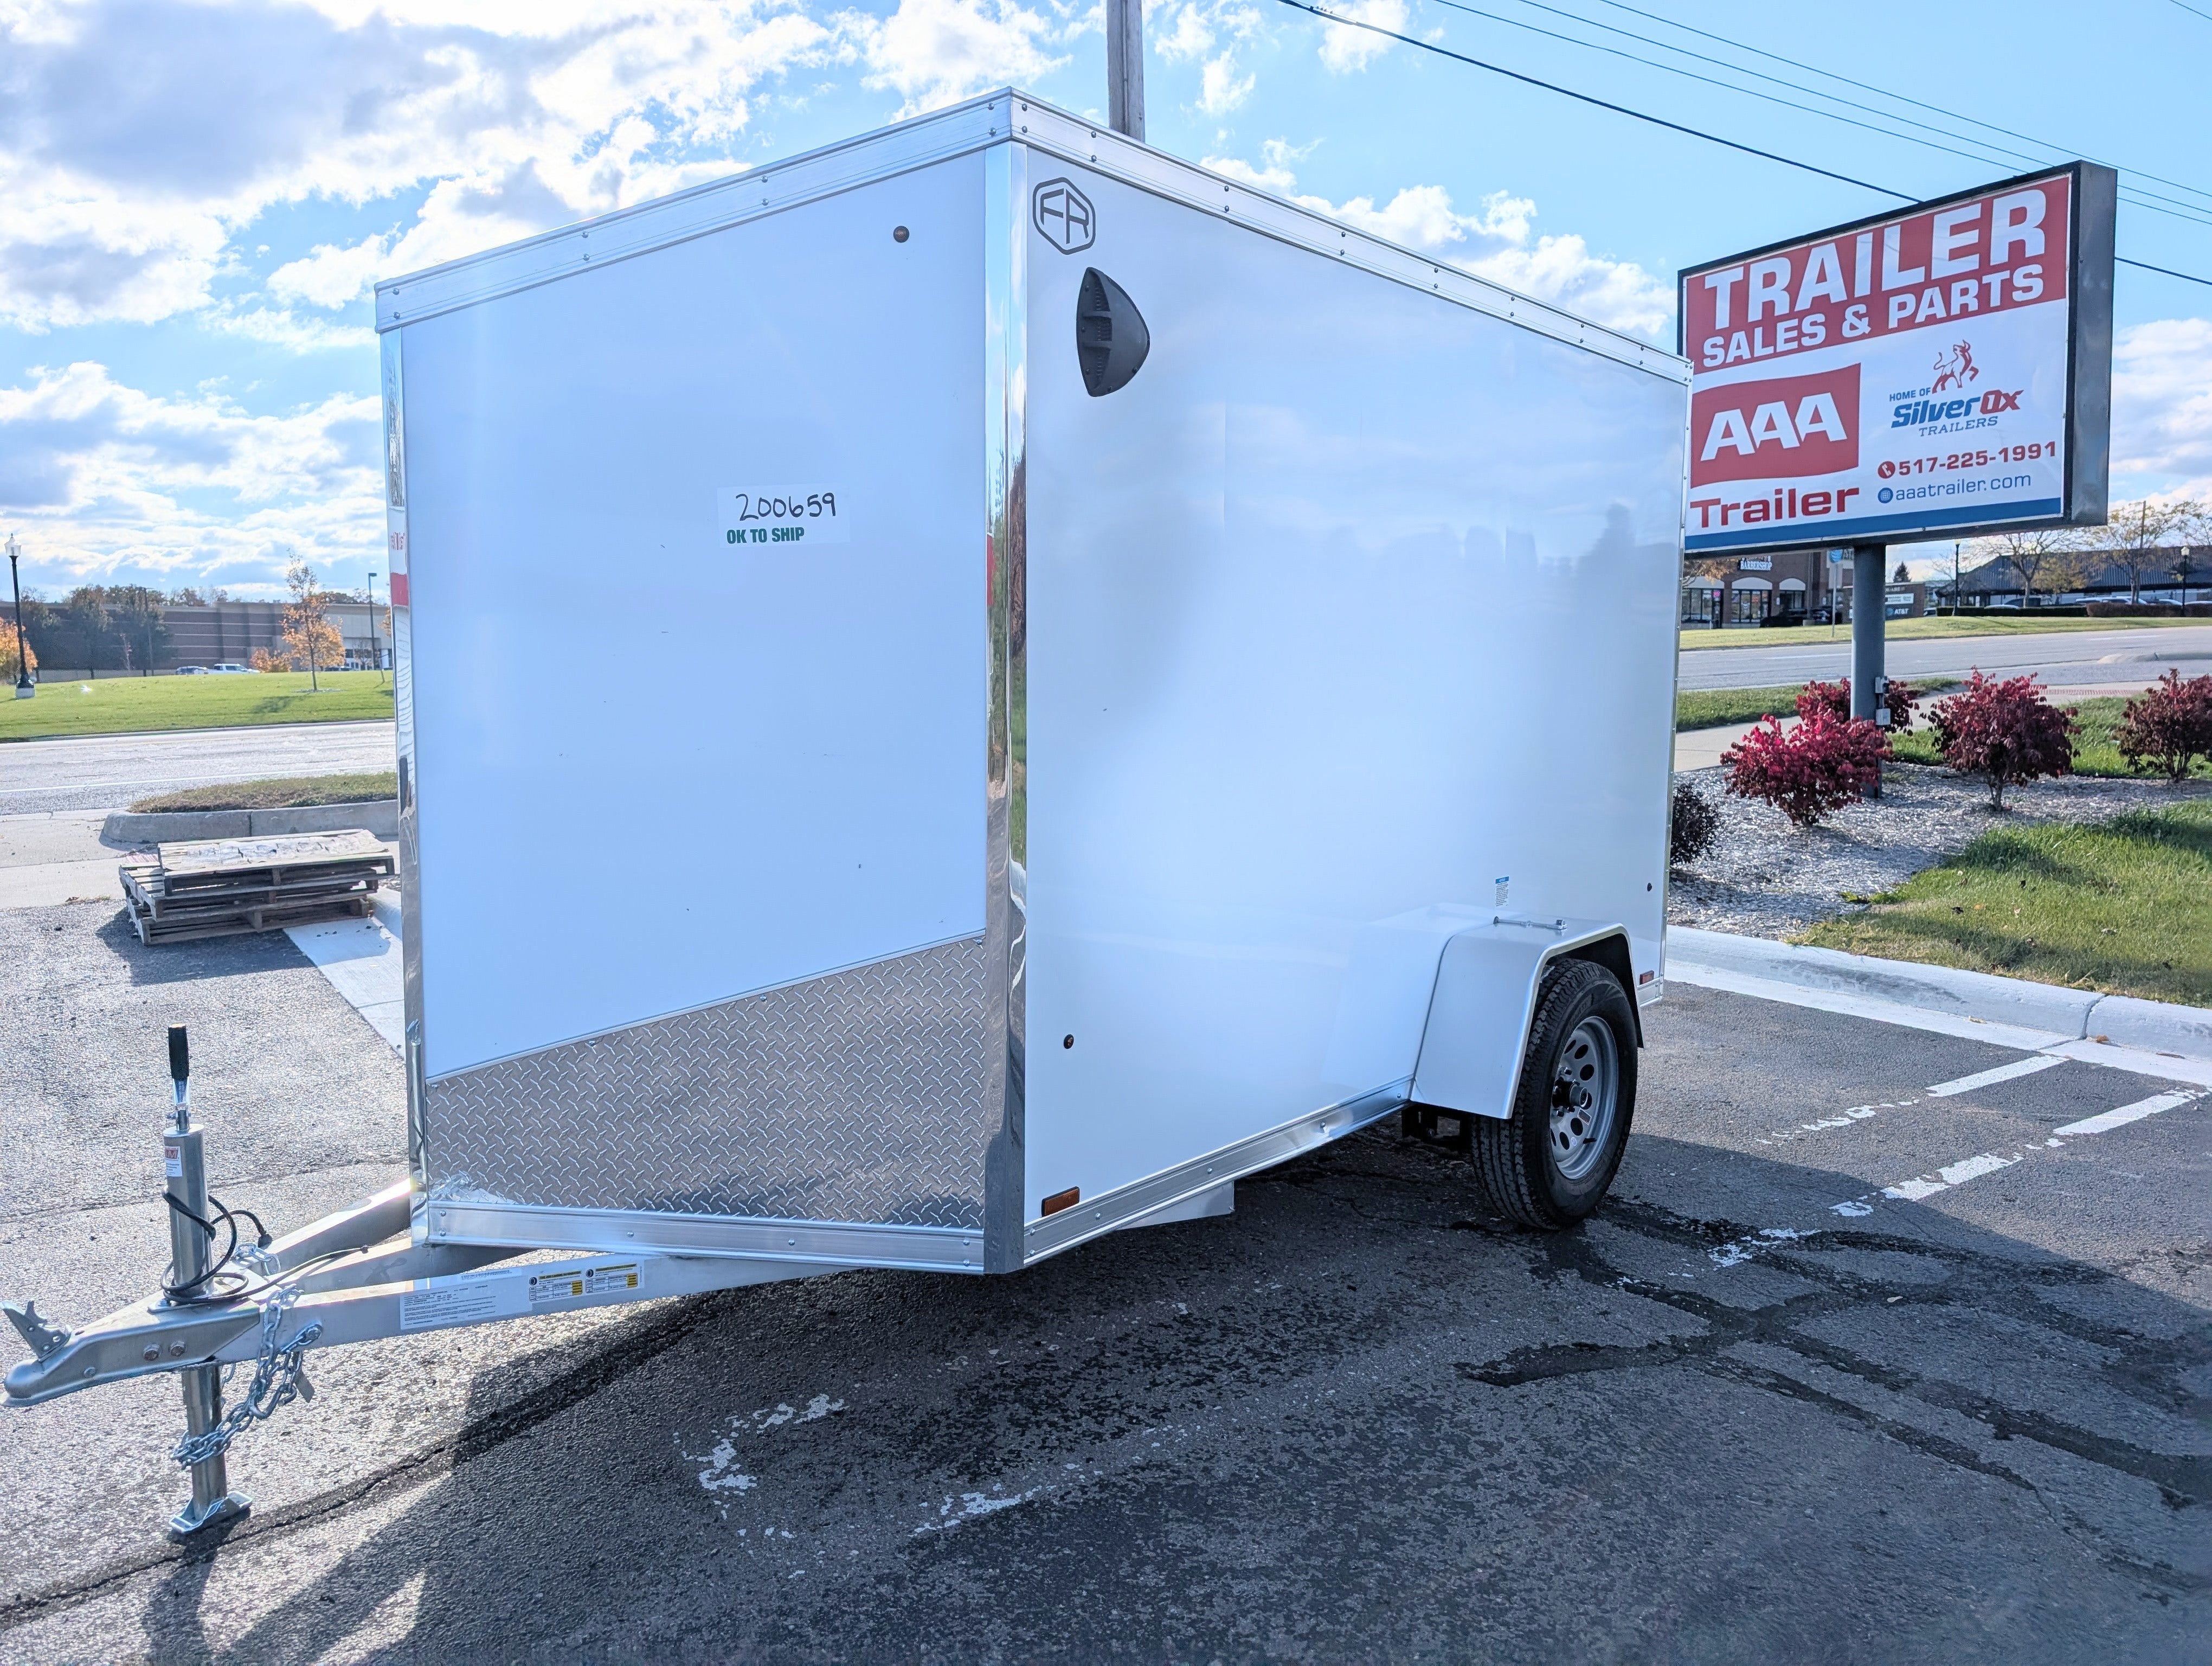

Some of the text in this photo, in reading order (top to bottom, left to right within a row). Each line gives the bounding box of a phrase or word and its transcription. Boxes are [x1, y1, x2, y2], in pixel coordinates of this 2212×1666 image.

[1705, 189, 2047, 330] TRAILER
[1703, 264, 2044, 368] SALES & PARTS
[1889, 387, 1931, 401] HOME OF
[1700, 392, 1848, 461] AAA
[1919, 416, 1998, 437] TRAILERS
[1899, 441, 2055, 476] 517-225-1991
[1896, 475, 2031, 501] aaatrailer.com
[736, 492, 836, 521] 200659
[1690, 488, 1859, 528] Trailer
[726, 527, 805, 544] OK TO SHIP
